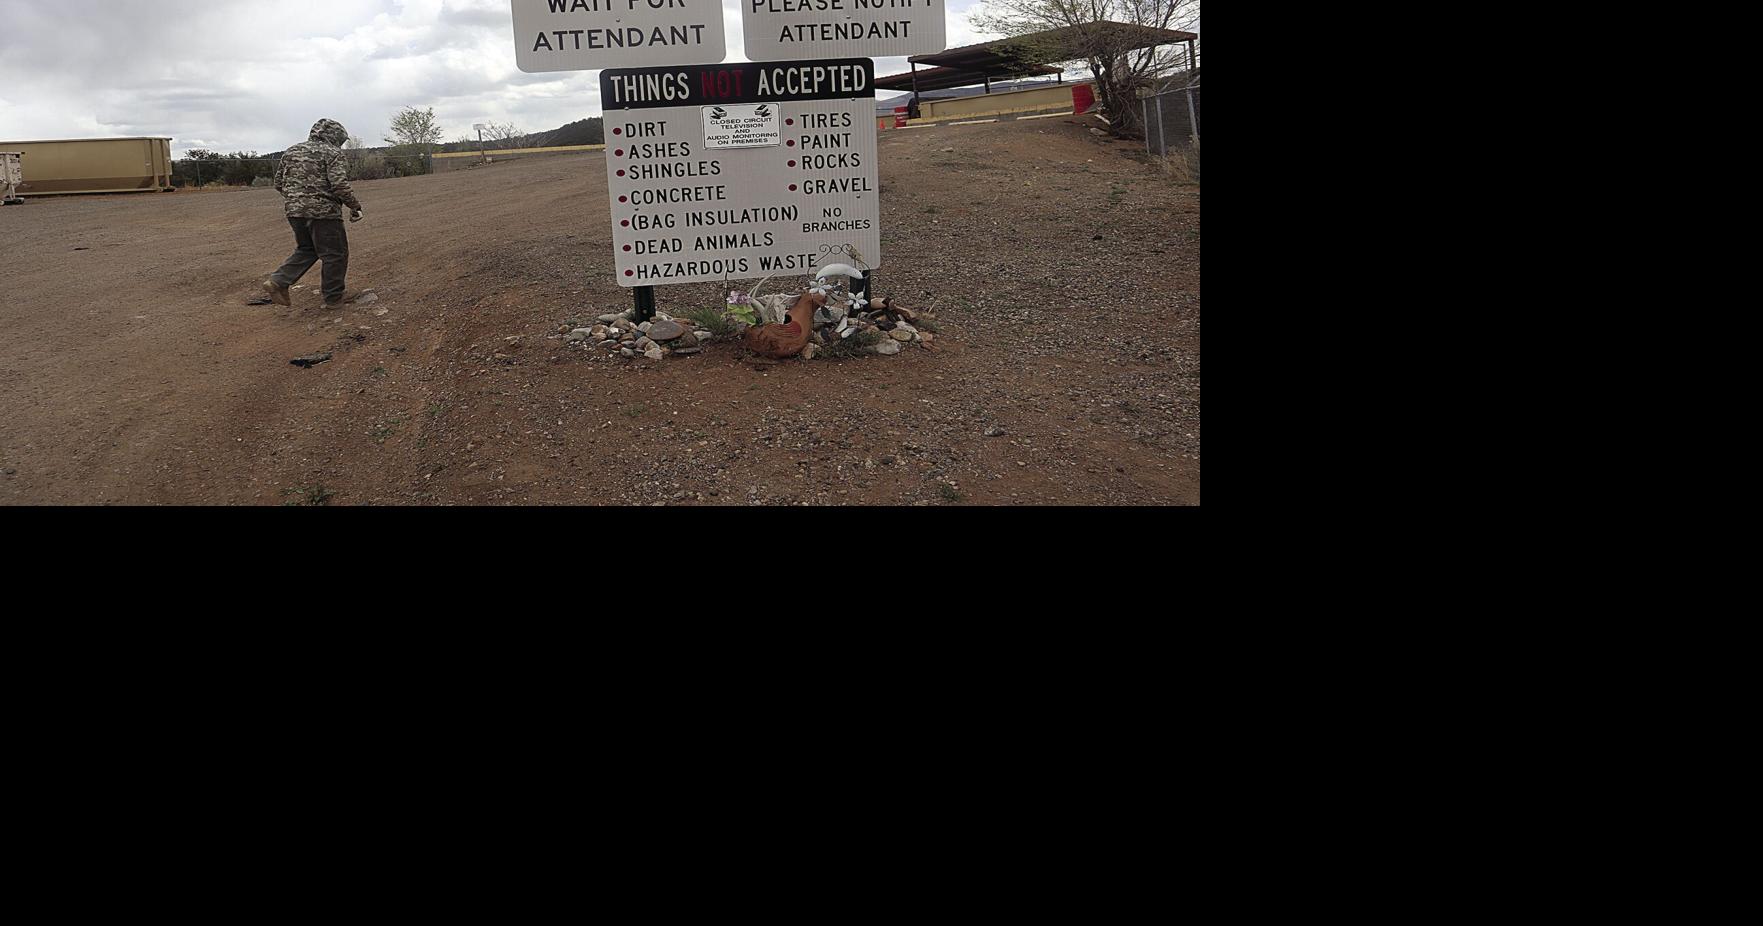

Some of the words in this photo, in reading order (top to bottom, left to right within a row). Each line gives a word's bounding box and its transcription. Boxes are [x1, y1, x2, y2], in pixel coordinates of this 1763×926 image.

[752, 0, 843, 13] PLEASE
[533, 25, 704, 51] ATTENDANT
[780, 21, 911, 42] ATTENDANT
[611, 73, 689, 102] THINGS
[701, 69, 744, 98] NOT
[758, 65, 865, 95] ACCEPTED
[626, 121, 666, 137] DIRT
[800, 113, 851, 128] TIRES
[801, 133, 851, 149] PAINT
[629, 142, 690, 159] ASHES
[802, 153, 860, 169] ROCKS
[630, 161, 720, 179] SHINGLES
[804, 177, 871, 194] GRAVEL
[631, 186, 726, 205] CONCRETE
[632, 214, 675, 230] (BAG
[686, 205, 798, 226] INSULATION)
[823, 208, 841, 217] NO
[803, 219, 870, 232] BRANCHES
[635, 239, 682, 254] DEAD
[695, 232, 773, 251] ANIMALS
[637, 258, 748, 279] HAZARDOUS
[759, 253, 818, 272] WASTE
